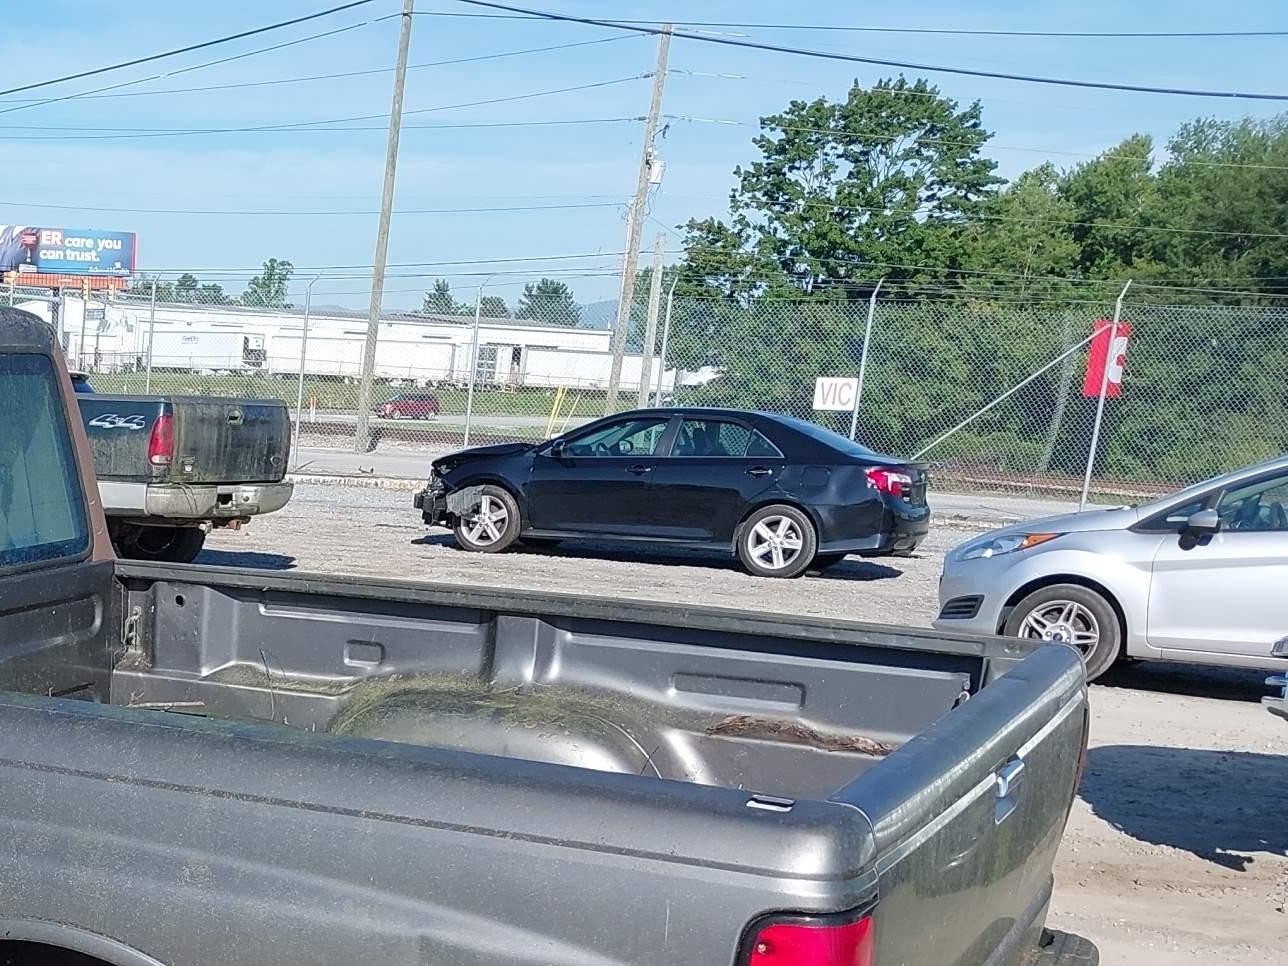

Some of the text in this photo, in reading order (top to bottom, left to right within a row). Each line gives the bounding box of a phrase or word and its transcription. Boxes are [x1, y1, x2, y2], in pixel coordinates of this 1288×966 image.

[40, 231, 122, 251] ER care you
[39, 248, 101, 262] can trust.
[820, 382, 853, 406] VIC
[88, 413, 146, 430] 4x4
